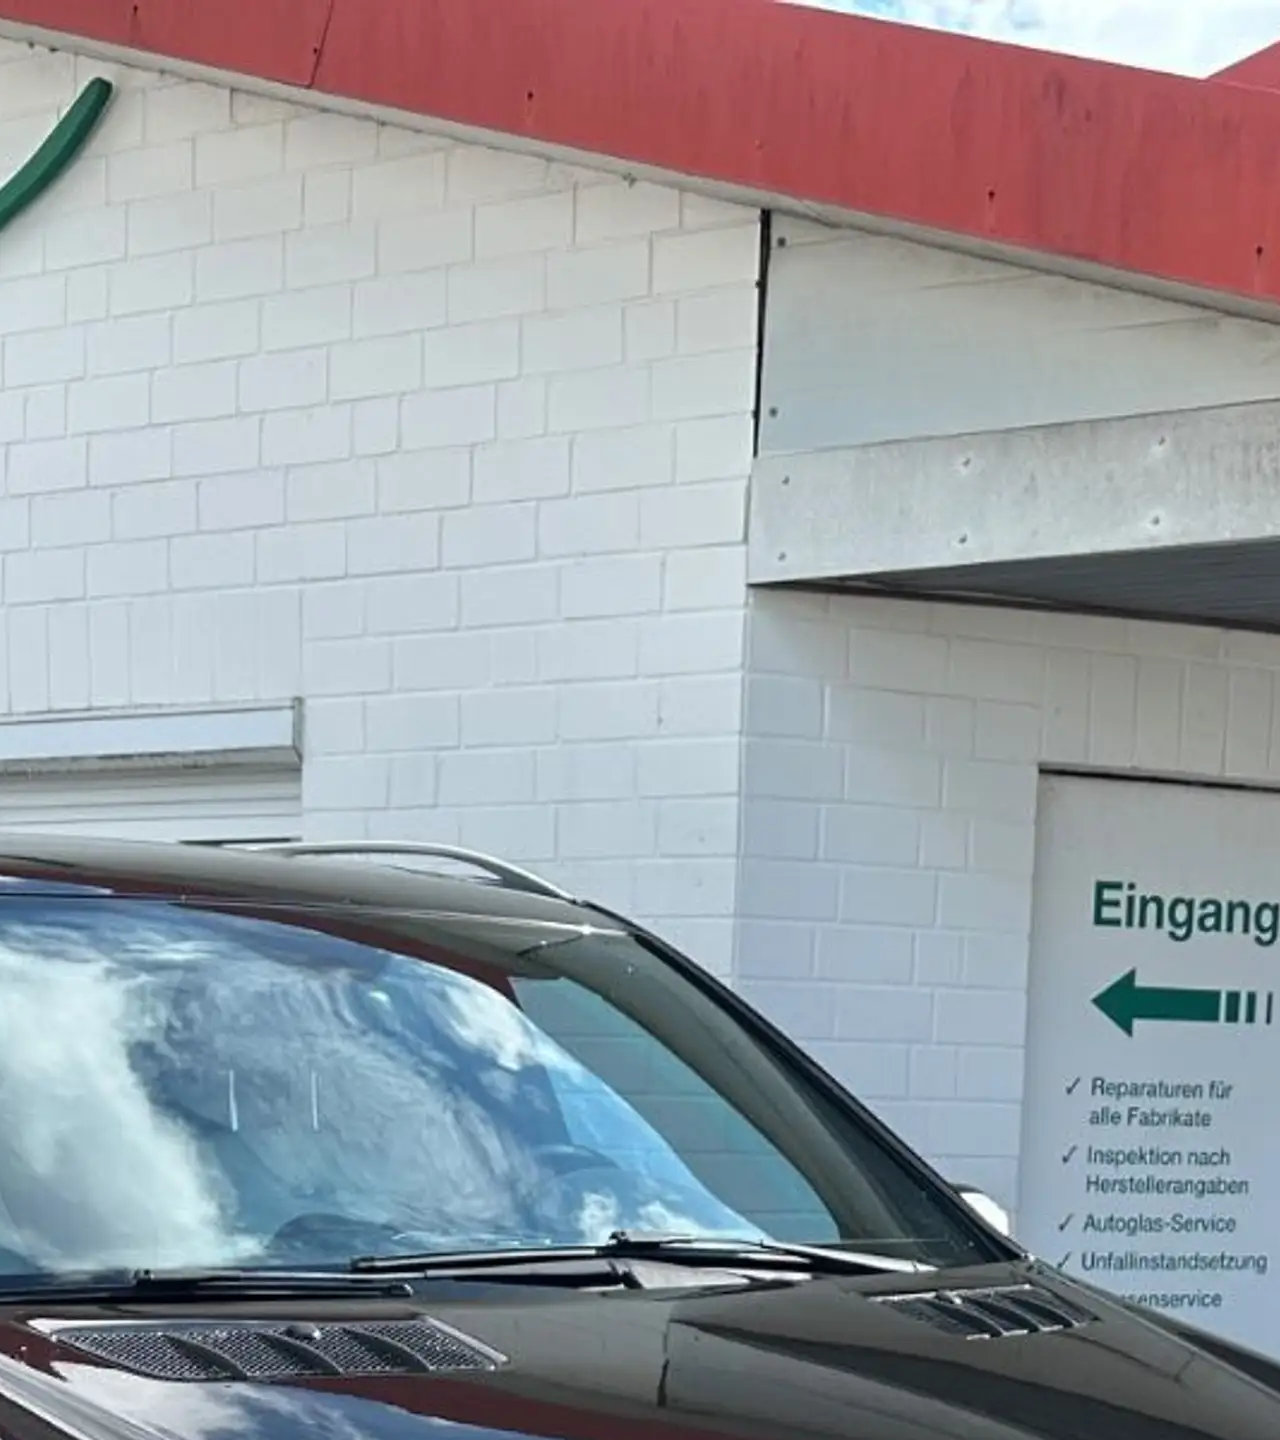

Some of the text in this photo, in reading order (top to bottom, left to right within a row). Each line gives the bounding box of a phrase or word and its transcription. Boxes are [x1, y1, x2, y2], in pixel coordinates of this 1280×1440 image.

[1093, 880, 1280, 947] Eingang
[1090, 1077, 1233, 1100] Reparaturen für
[1089, 1106, 1212, 1127] alle Fabrikate
[1087, 1146, 1231, 1168] Inspektion nach
[1086, 1175, 1249, 1198] Herstellerangaben
[1083, 1213, 1236, 1236] Autoglas-Service
[1081, 1251, 1268, 1274] Unfallinstandsetzung
